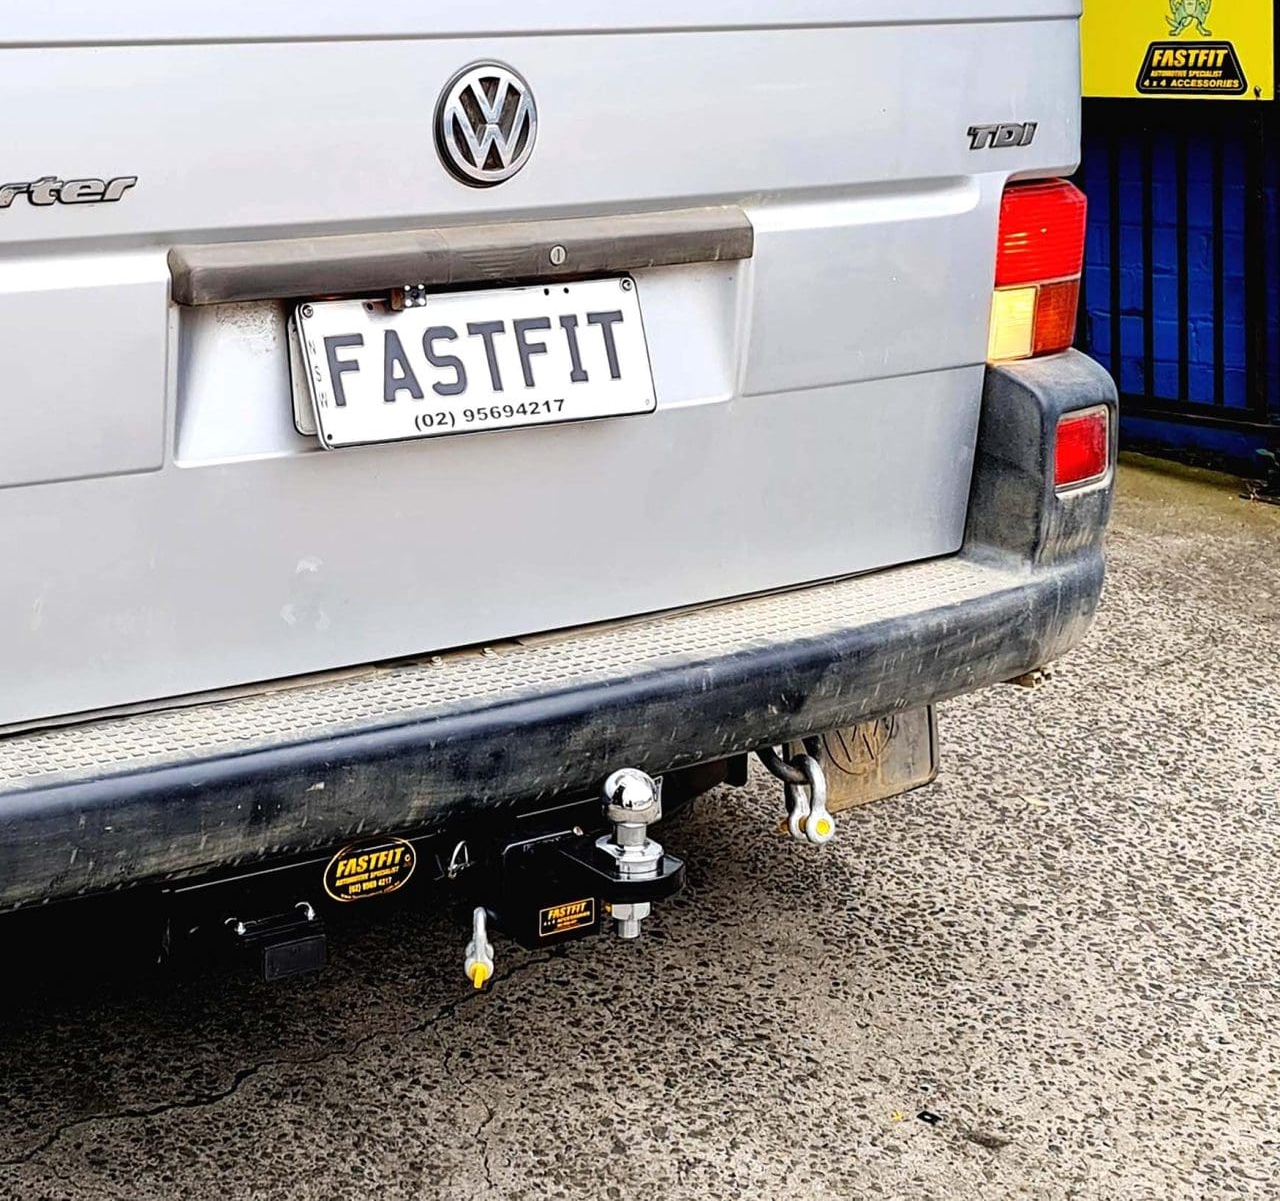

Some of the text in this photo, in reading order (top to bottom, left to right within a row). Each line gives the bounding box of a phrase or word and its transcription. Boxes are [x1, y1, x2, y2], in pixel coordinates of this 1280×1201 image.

[1151, 49, 1228, 68] FASTFIT
[1170, 79, 1239, 88] ACCESSORIES
[966, 122, 1038, 150] TDI
[323, 310, 624, 407] FASTFIT
[414, 399, 565, 432] (02) 95694217
[336, 847, 405, 878] FASTFIT
[548, 902, 587, 920] FASTFIT
